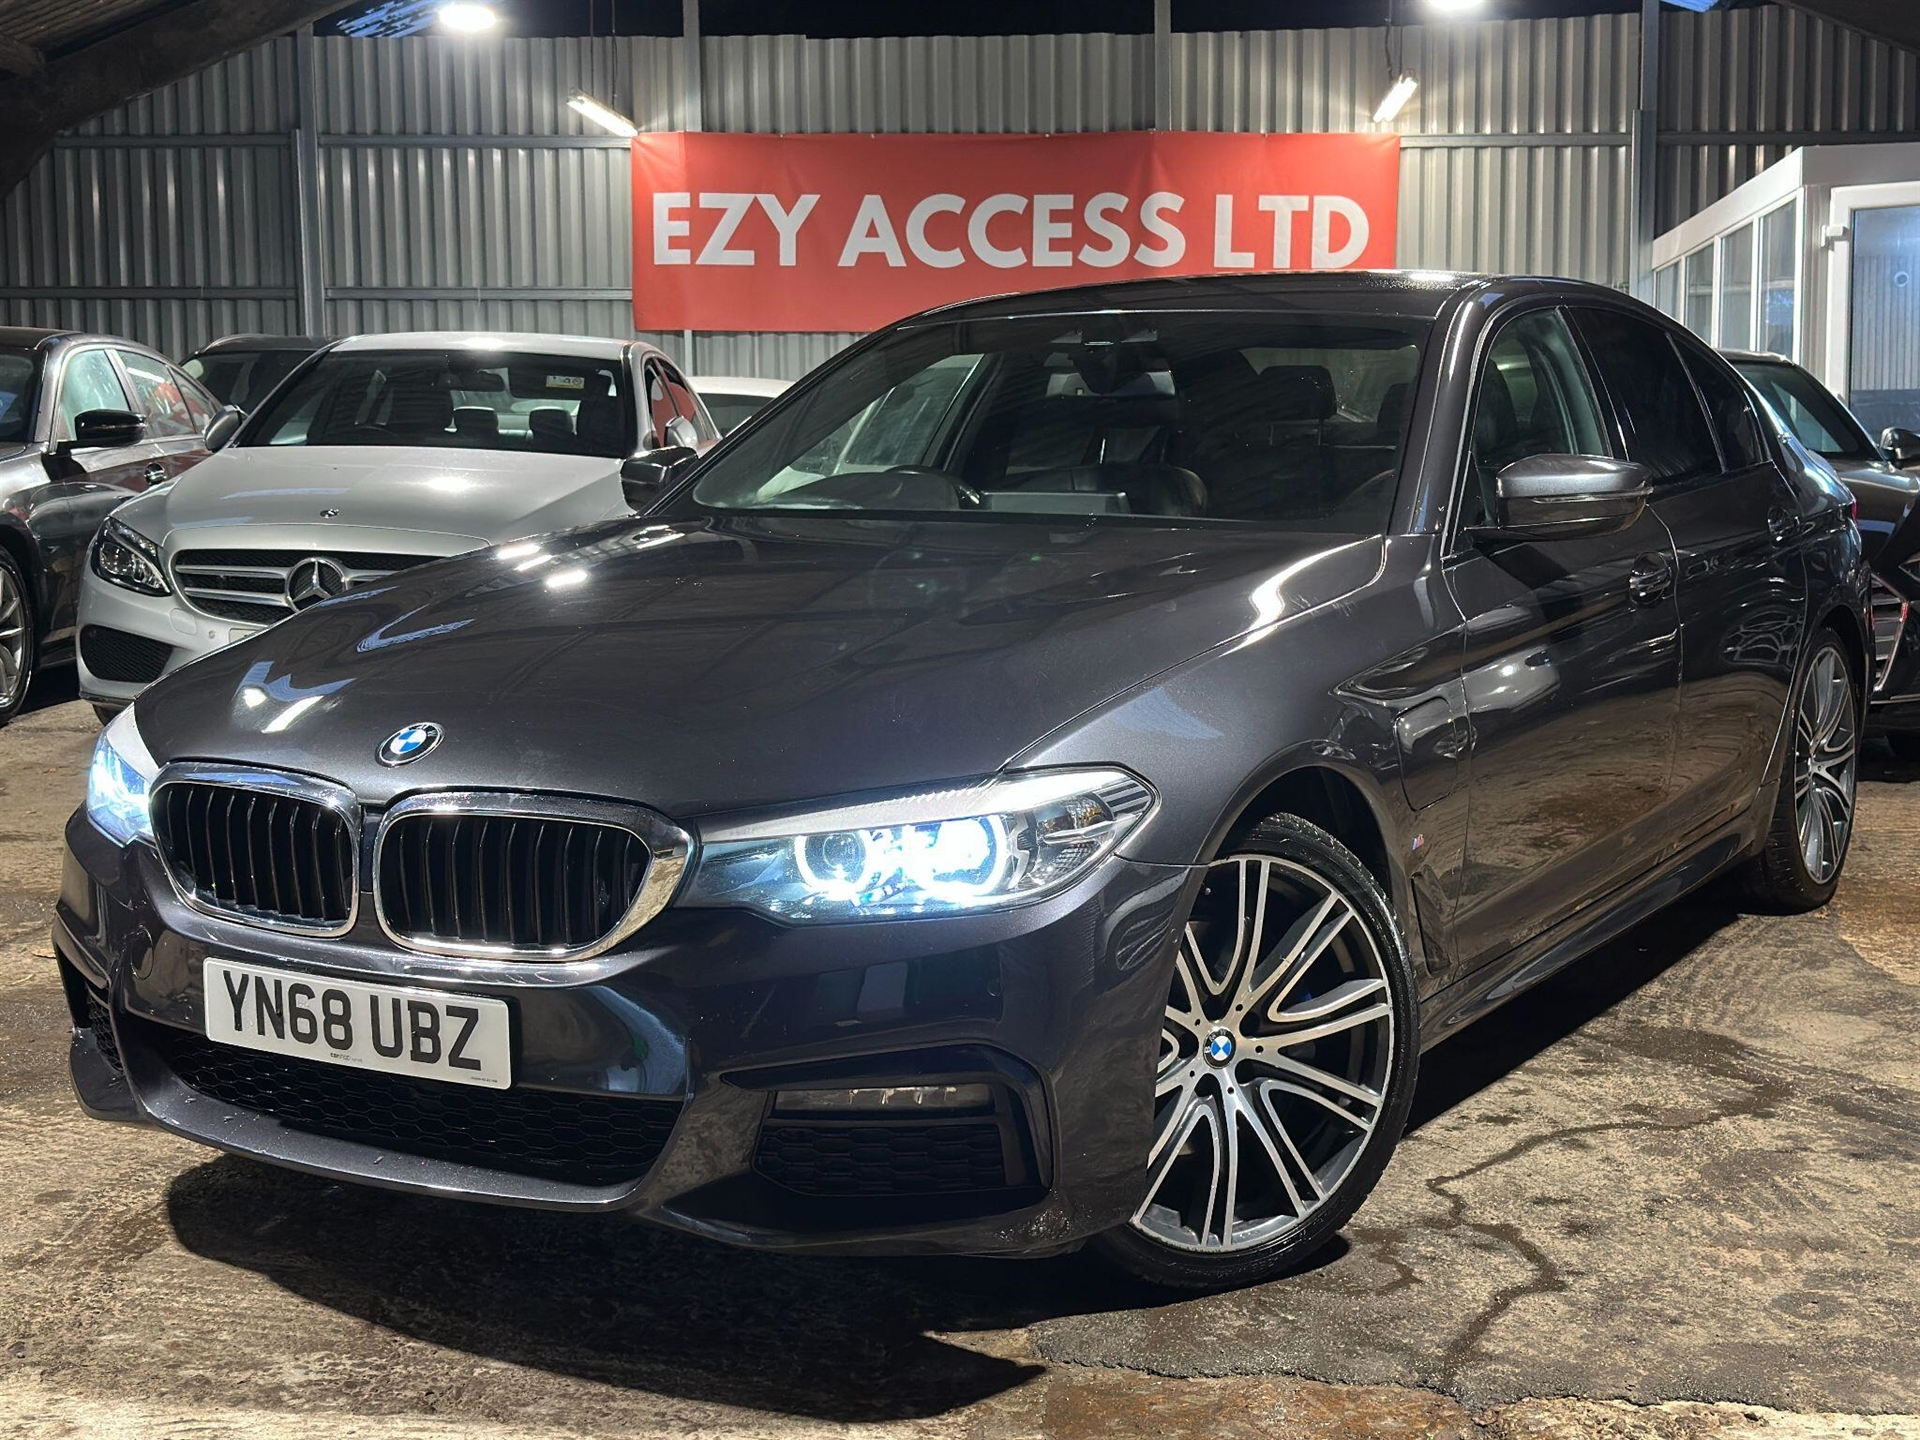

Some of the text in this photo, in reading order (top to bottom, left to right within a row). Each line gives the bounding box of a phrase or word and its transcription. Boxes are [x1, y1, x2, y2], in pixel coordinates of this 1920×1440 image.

[652, 192, 1369, 269] EZY ACCESS LTD
[223, 970, 481, 1071] YN68 UBZ
